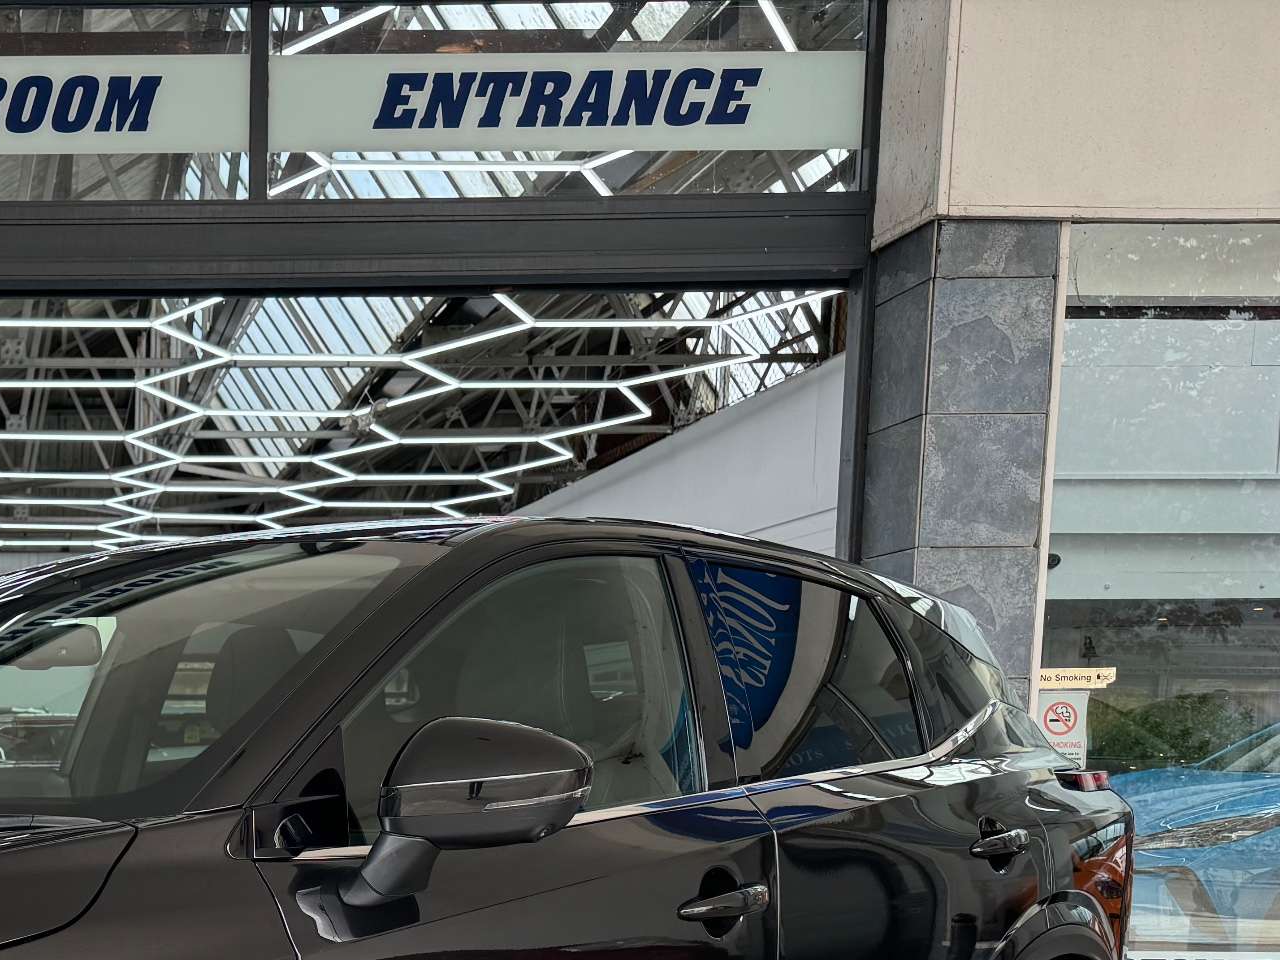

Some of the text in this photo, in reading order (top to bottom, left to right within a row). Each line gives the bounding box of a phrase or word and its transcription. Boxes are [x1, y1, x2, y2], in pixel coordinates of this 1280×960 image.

[372, 67, 764, 130] ENTRANCE
[1040, 674, 1092, 683] No Smoking
